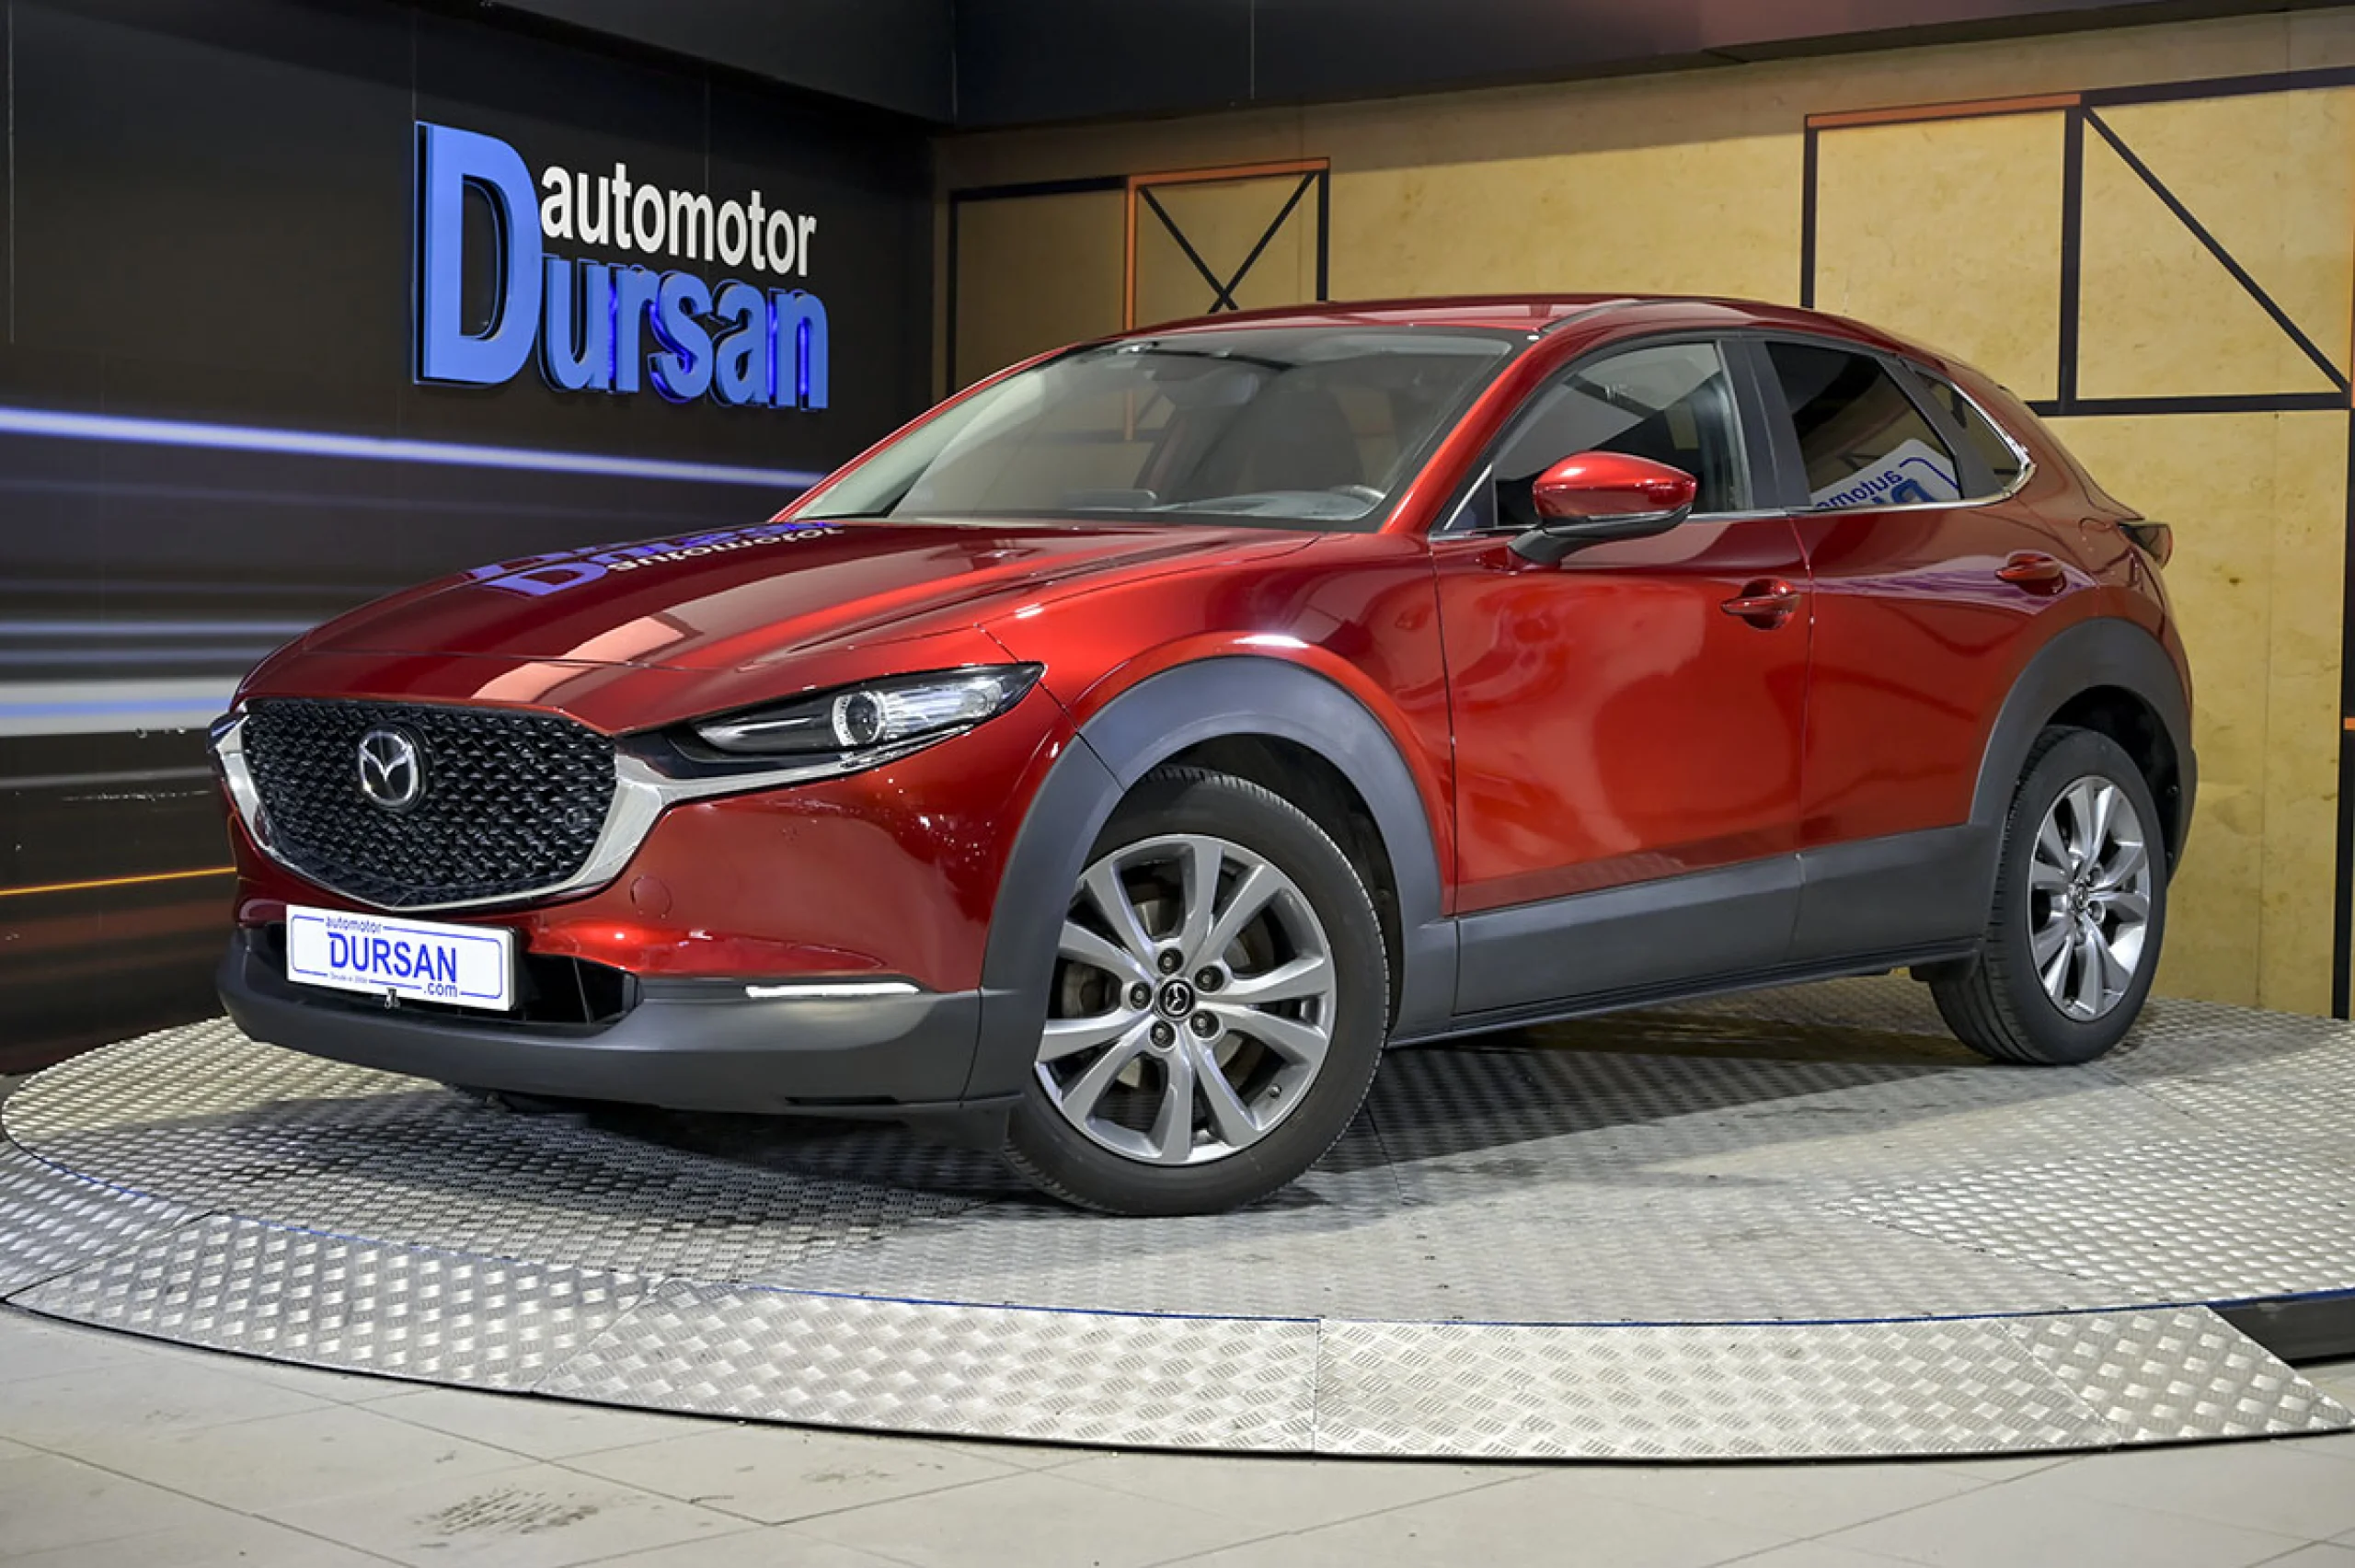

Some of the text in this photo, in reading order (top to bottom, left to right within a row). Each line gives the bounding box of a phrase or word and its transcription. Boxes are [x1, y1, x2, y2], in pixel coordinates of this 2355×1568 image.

[540, 162, 818, 277] automotor
[413, 120, 830, 411] Dursan
[326, 915, 383, 934] automotor
[327, 931, 458, 983] DURSAN
[423, 982, 458, 998] .com
